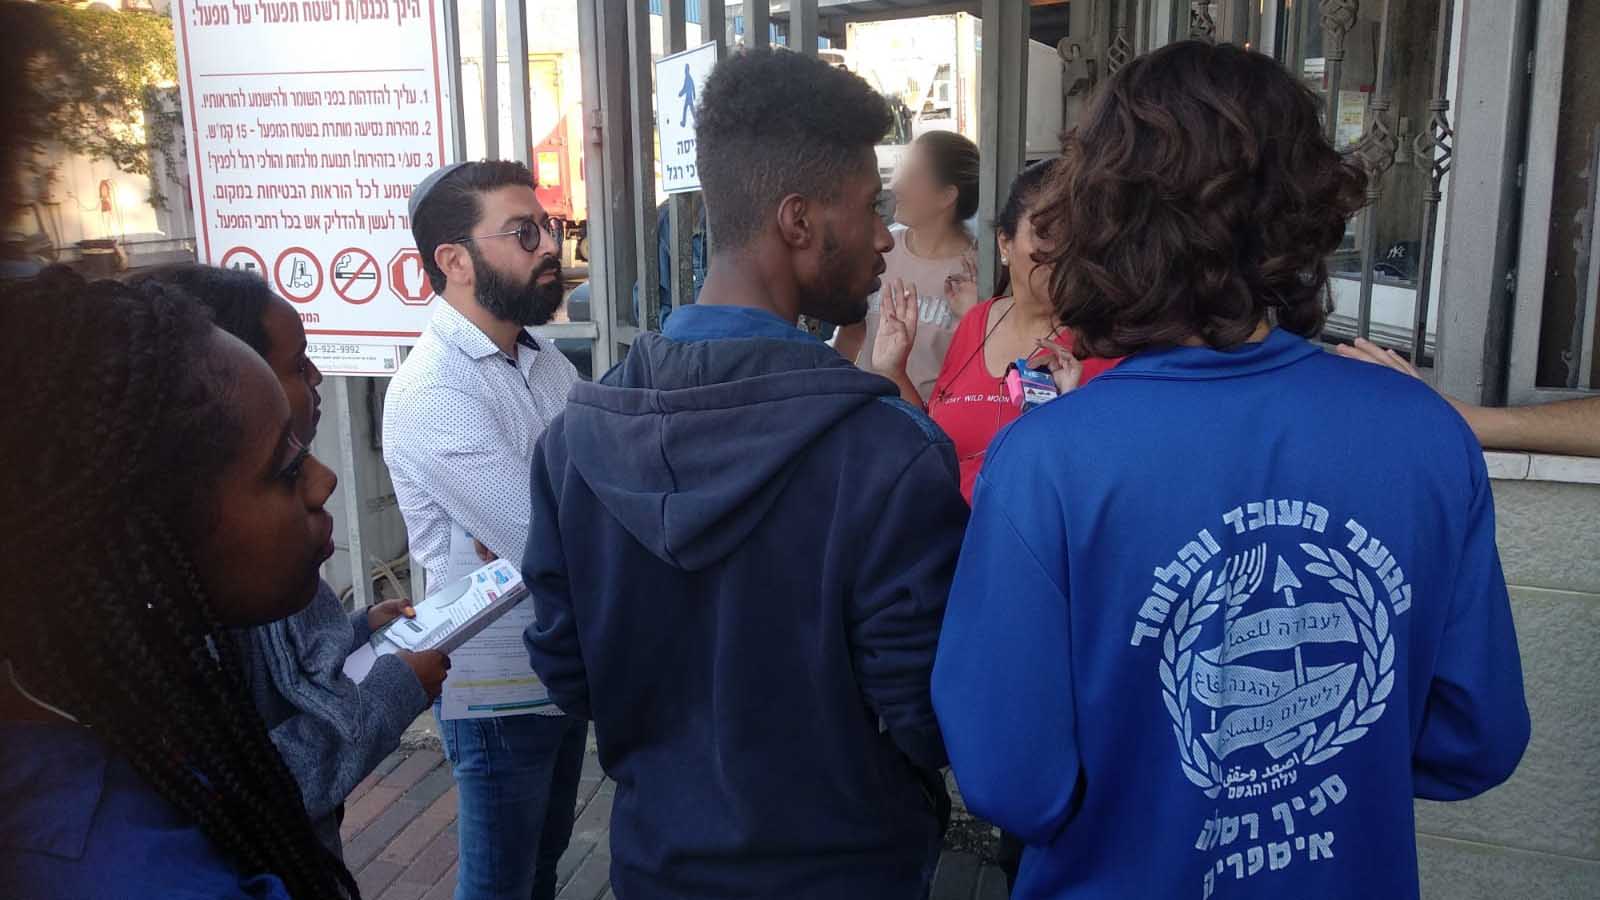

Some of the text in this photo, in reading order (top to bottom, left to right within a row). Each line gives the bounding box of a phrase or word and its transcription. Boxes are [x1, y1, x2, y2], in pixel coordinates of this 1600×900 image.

[192, 0, 230, 26] מפעל:
[232, 0, 252, 24] של
[255, 0, 299, 24] תפעולי
[302, 0, 340, 22] לשטח
[201, 83, 429, 110] 1. עליך להזדהות בפני השומר ולהישמע להוראותיו.
[236, 124, 248, 139] 15
[257, 117, 289, 139] המפעל
[291, 122, 319, 138] בשטח
[321, 121, 352, 138] מותרת
[354, 121, 383, 136] נסיעה
[385, 120, 419, 136] מהירות
[422, 120, 432, 136] 2.
[207, 149, 236, 174] לפניך!
[238, 150, 256, 169] רגל
[257, 149, 284, 169] והולכי
[286, 148, 319, 169] מלגזות
[320, 152, 351, 168] תנועת
[353, 149, 396, 169] בזהירות!
[424, 152, 433, 168] 3.
[666, 164, 683, 181] רגל
[213, 184, 253, 204] במקום.
[257, 184, 306, 199] הבטיחות
[311, 184, 352, 199] הוראות
[356, 178, 379, 199] לכל
[215, 209, 252, 229] המפעל.
[255, 214, 278, 229] רחבי
[280, 209, 301, 229] בכל
[304, 214, 320, 229] אש
[323, 209, 365, 234] ולהדליק
[367, 209, 395, 235] לעשן
[1130, 499, 1412, 646] הנוער העובד והלומד
[1278, 612, 1341, 636] לעבודה
[1228, 678, 1281, 698] להגנה
[1280, 683, 1342, 722] ולשלום
[1271, 769, 1298, 790] עלה
[1271, 773, 1348, 836] סניף
